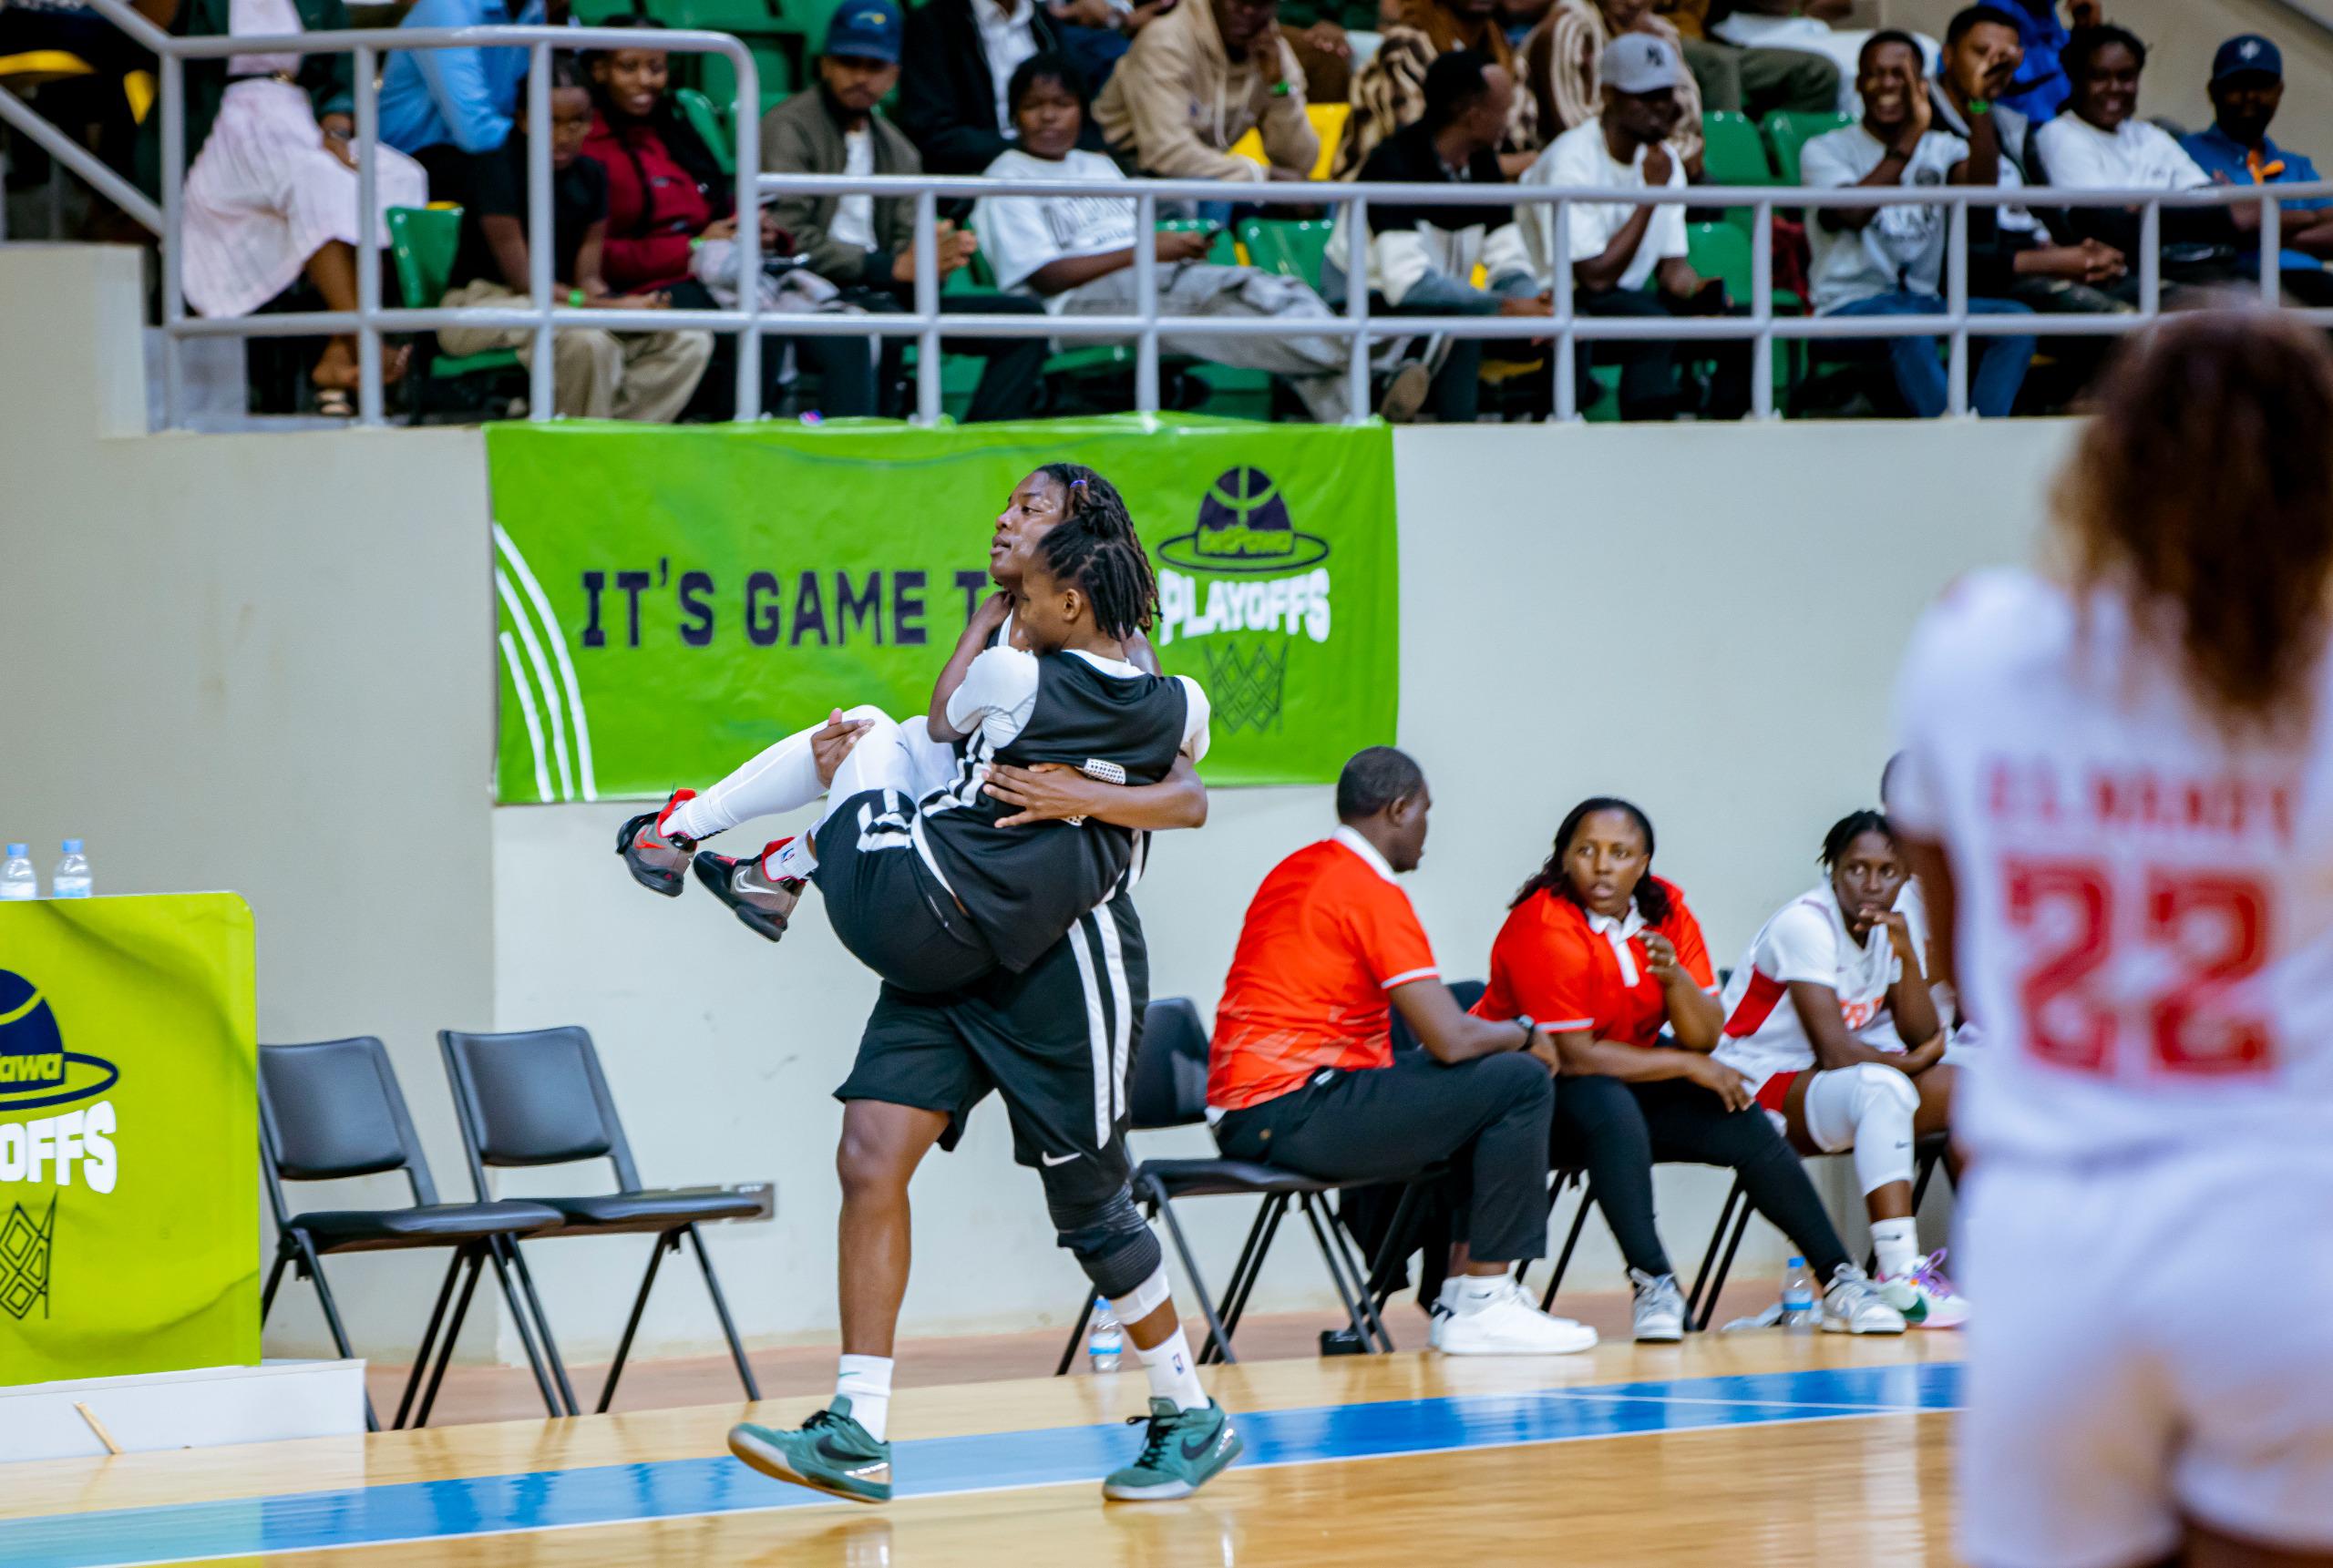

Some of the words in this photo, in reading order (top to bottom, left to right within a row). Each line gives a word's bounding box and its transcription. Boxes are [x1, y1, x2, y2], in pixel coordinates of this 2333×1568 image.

[582, 557, 714, 648] IT'S
[745, 570, 928, 647] GAME
[1158, 568, 1331, 647] PLAYOFFS
[2001, 856, 2271, 1081] 22
[0, 1101, 117, 1194] OFFS
